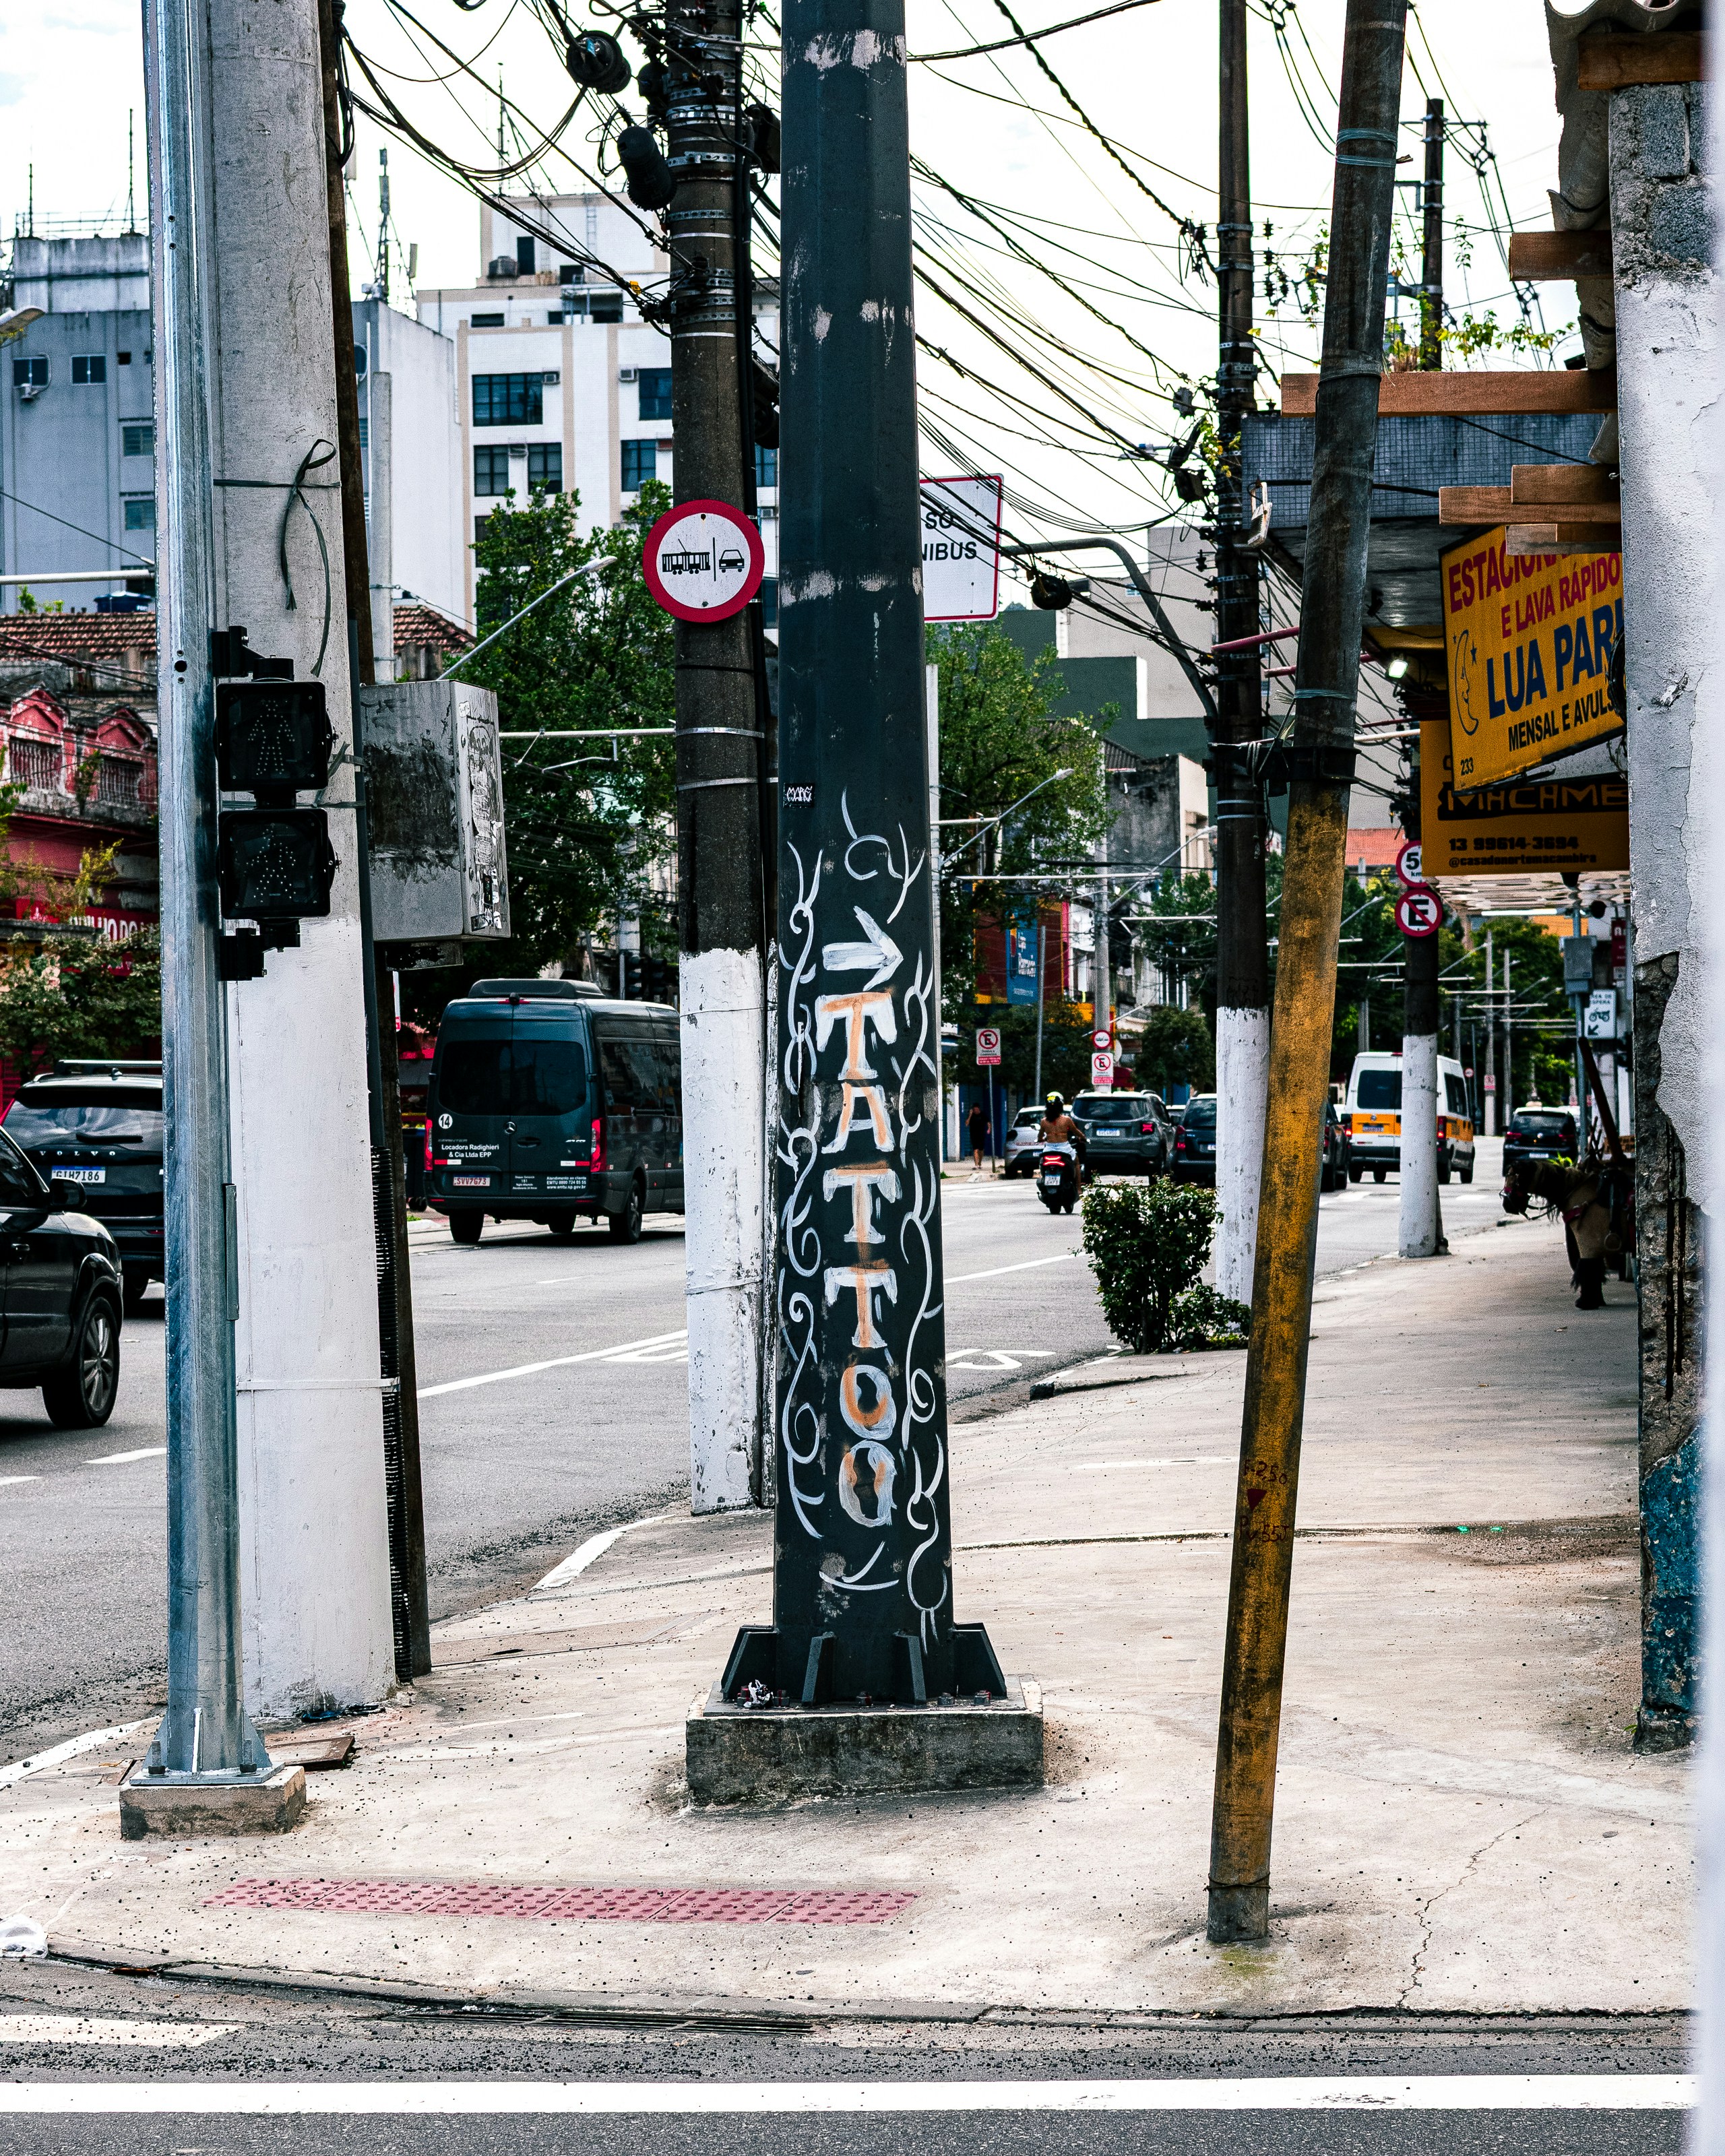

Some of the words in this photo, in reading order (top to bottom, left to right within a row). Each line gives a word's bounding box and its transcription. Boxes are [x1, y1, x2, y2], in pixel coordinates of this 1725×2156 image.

[1501, 604, 1511, 639] E
[1516, 584, 1555, 632] LAVA
[1559, 553, 1621, 611] RÁPIDO
[1486, 639, 1548, 719] LUA
[1508, 711, 1559, 752] MENSAL
[1563, 704, 1571, 732] E
[1460, 757, 1474, 776] 233
[1449, 837, 1468, 851] 13
[1406, 852, 1422, 870] 5
[1408, 899, 1429, 926] E
[440, 1116, 450, 1127] 14
[816, 992, 898, 1528] TATTOO
